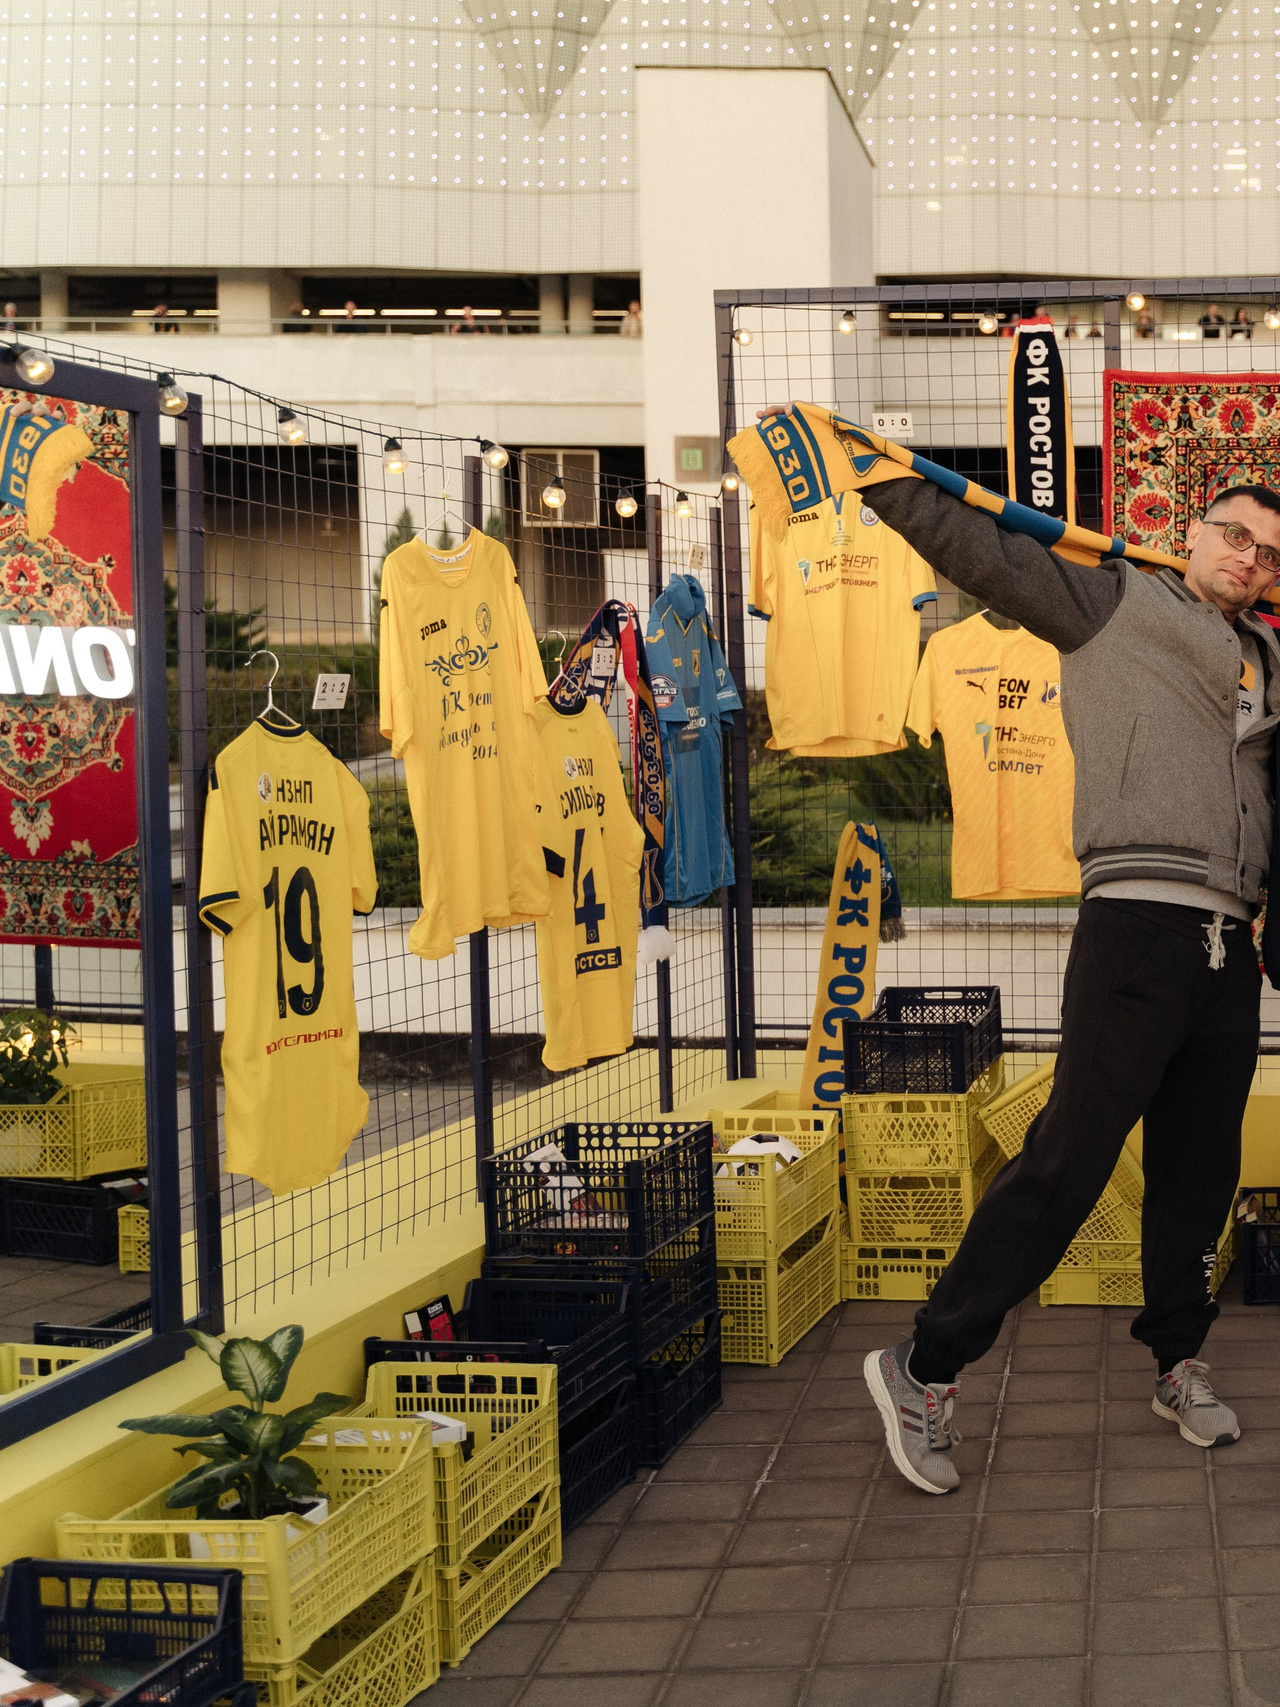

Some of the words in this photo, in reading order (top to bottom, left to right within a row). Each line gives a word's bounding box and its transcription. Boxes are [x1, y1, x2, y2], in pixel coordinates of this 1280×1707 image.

[1025, 338, 1050, 386] ФК
[761, 415, 810, 503] 1930
[1027, 397, 1054, 508] РОСТОВ
[998, 678, 1031, 694] FON
[998, 694, 1028, 709] BET
[641, 709, 661, 815] 09.03.2017
[1018, 733, 1056, 747] ЭНЕРГО
[276, 779, 313, 804] НЗНП
[259, 810, 335, 855] АЙРАМЯН
[263, 866, 325, 1019] 19
